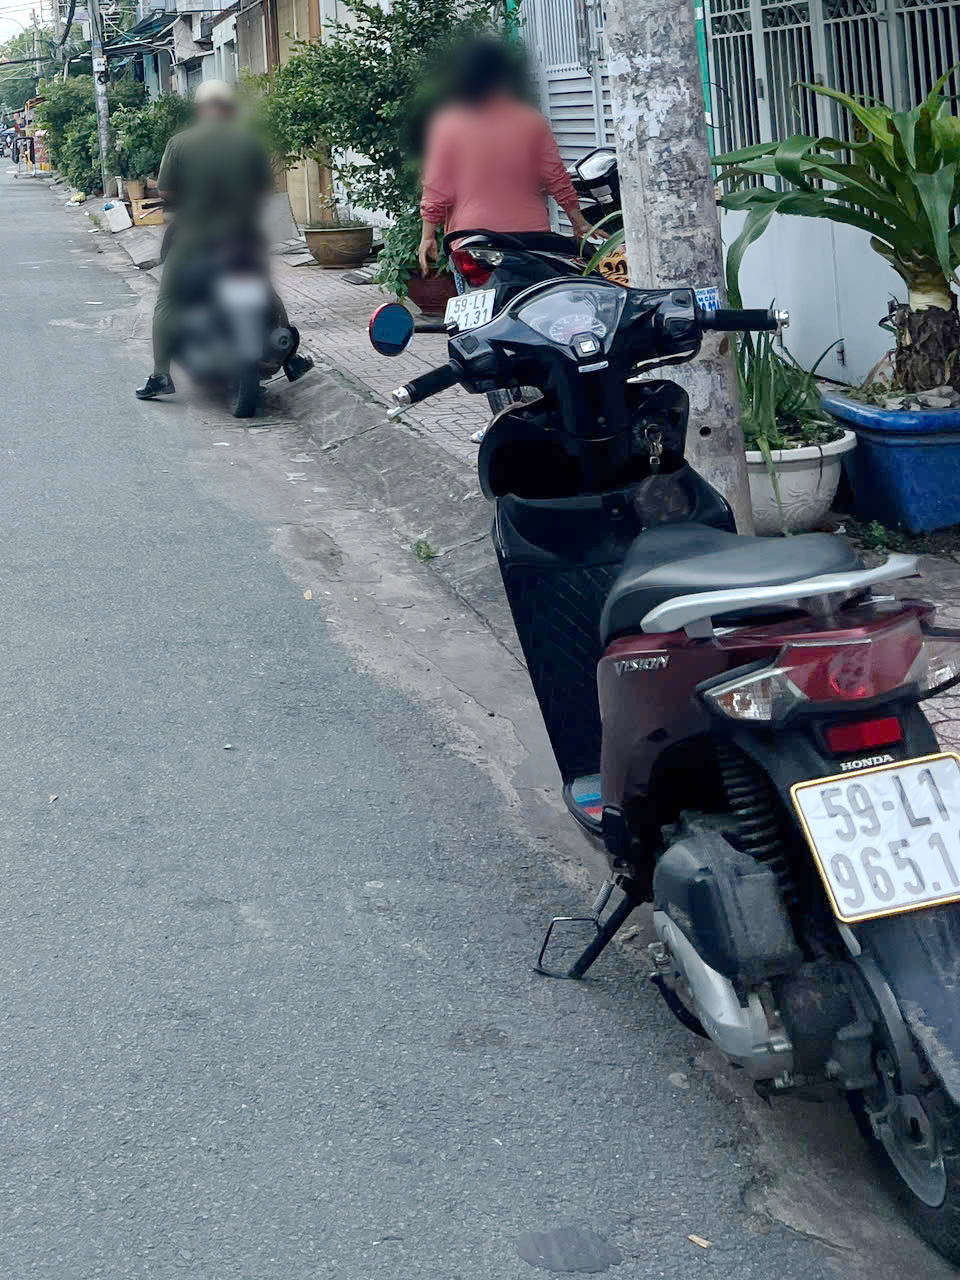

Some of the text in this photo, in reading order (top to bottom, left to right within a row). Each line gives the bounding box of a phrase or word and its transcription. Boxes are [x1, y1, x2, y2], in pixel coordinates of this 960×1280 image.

[614, 655, 670, 677] VISION
[840, 754, 895, 771] HONDA
[820, 768, 950, 842] 59-L1
[830, 831, 960, 909] 965.1
